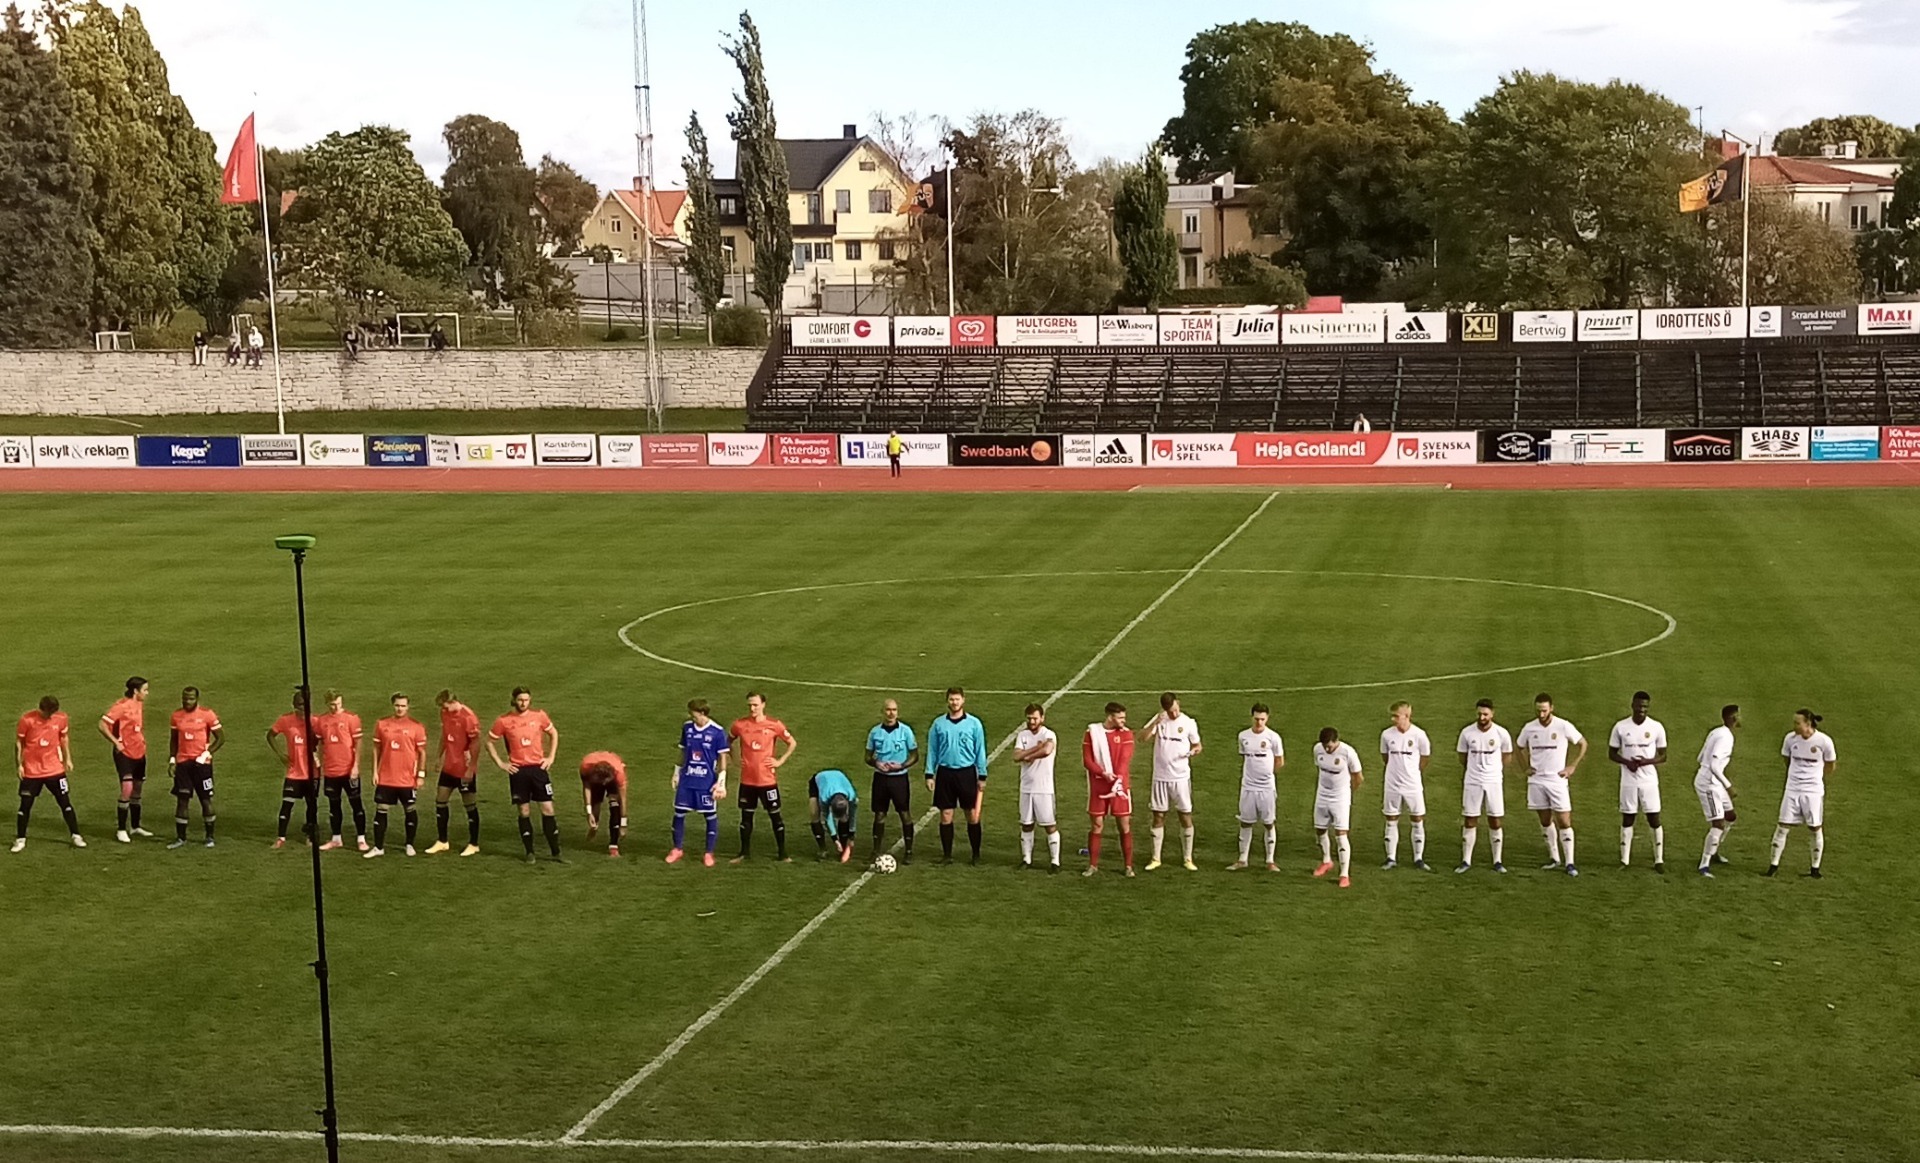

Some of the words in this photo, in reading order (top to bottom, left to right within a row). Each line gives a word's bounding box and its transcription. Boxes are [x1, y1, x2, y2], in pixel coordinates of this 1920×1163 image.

[1656, 313, 1721, 328] IDROTTENS
[1723, 310, 1732, 327] Ö
[1791, 310, 1819, 320] Strand
[1820, 309, 1847, 319] Hotell
[809, 323, 850, 335] COMFORT
[1182, 319, 1213, 329] TEAM
[1232, 318, 1274, 337] Julia
[900, 325, 935, 338] privab
[1164, 331, 1212, 341] SPORTIA
[1395, 331, 1432, 340] adidas
[1519, 325, 1566, 338] Bertwig
[1751, 430, 1800, 442] EHABS
[1889, 429, 1903, 437] ICA
[780, 437, 793, 445] ICA
[1422, 442, 1471, 450] SVENSKA
[40, 445, 69, 459] skylt
[85, 445, 129, 456] reklam
[780, 445, 831, 457] Atterdags
[960, 445, 1029, 457] Swedbank
[1176, 443, 1224, 451] SVENSKA
[1255, 442, 1293, 460] Heja
[1294, 441, 1366, 457] Gotland!
[1673, 445, 1731, 456] VISBYGG
[1095, 454, 1134, 464] adidas
[1176, 453, 1201, 461] SPEL
[1422, 451, 1448, 460] SPEL
